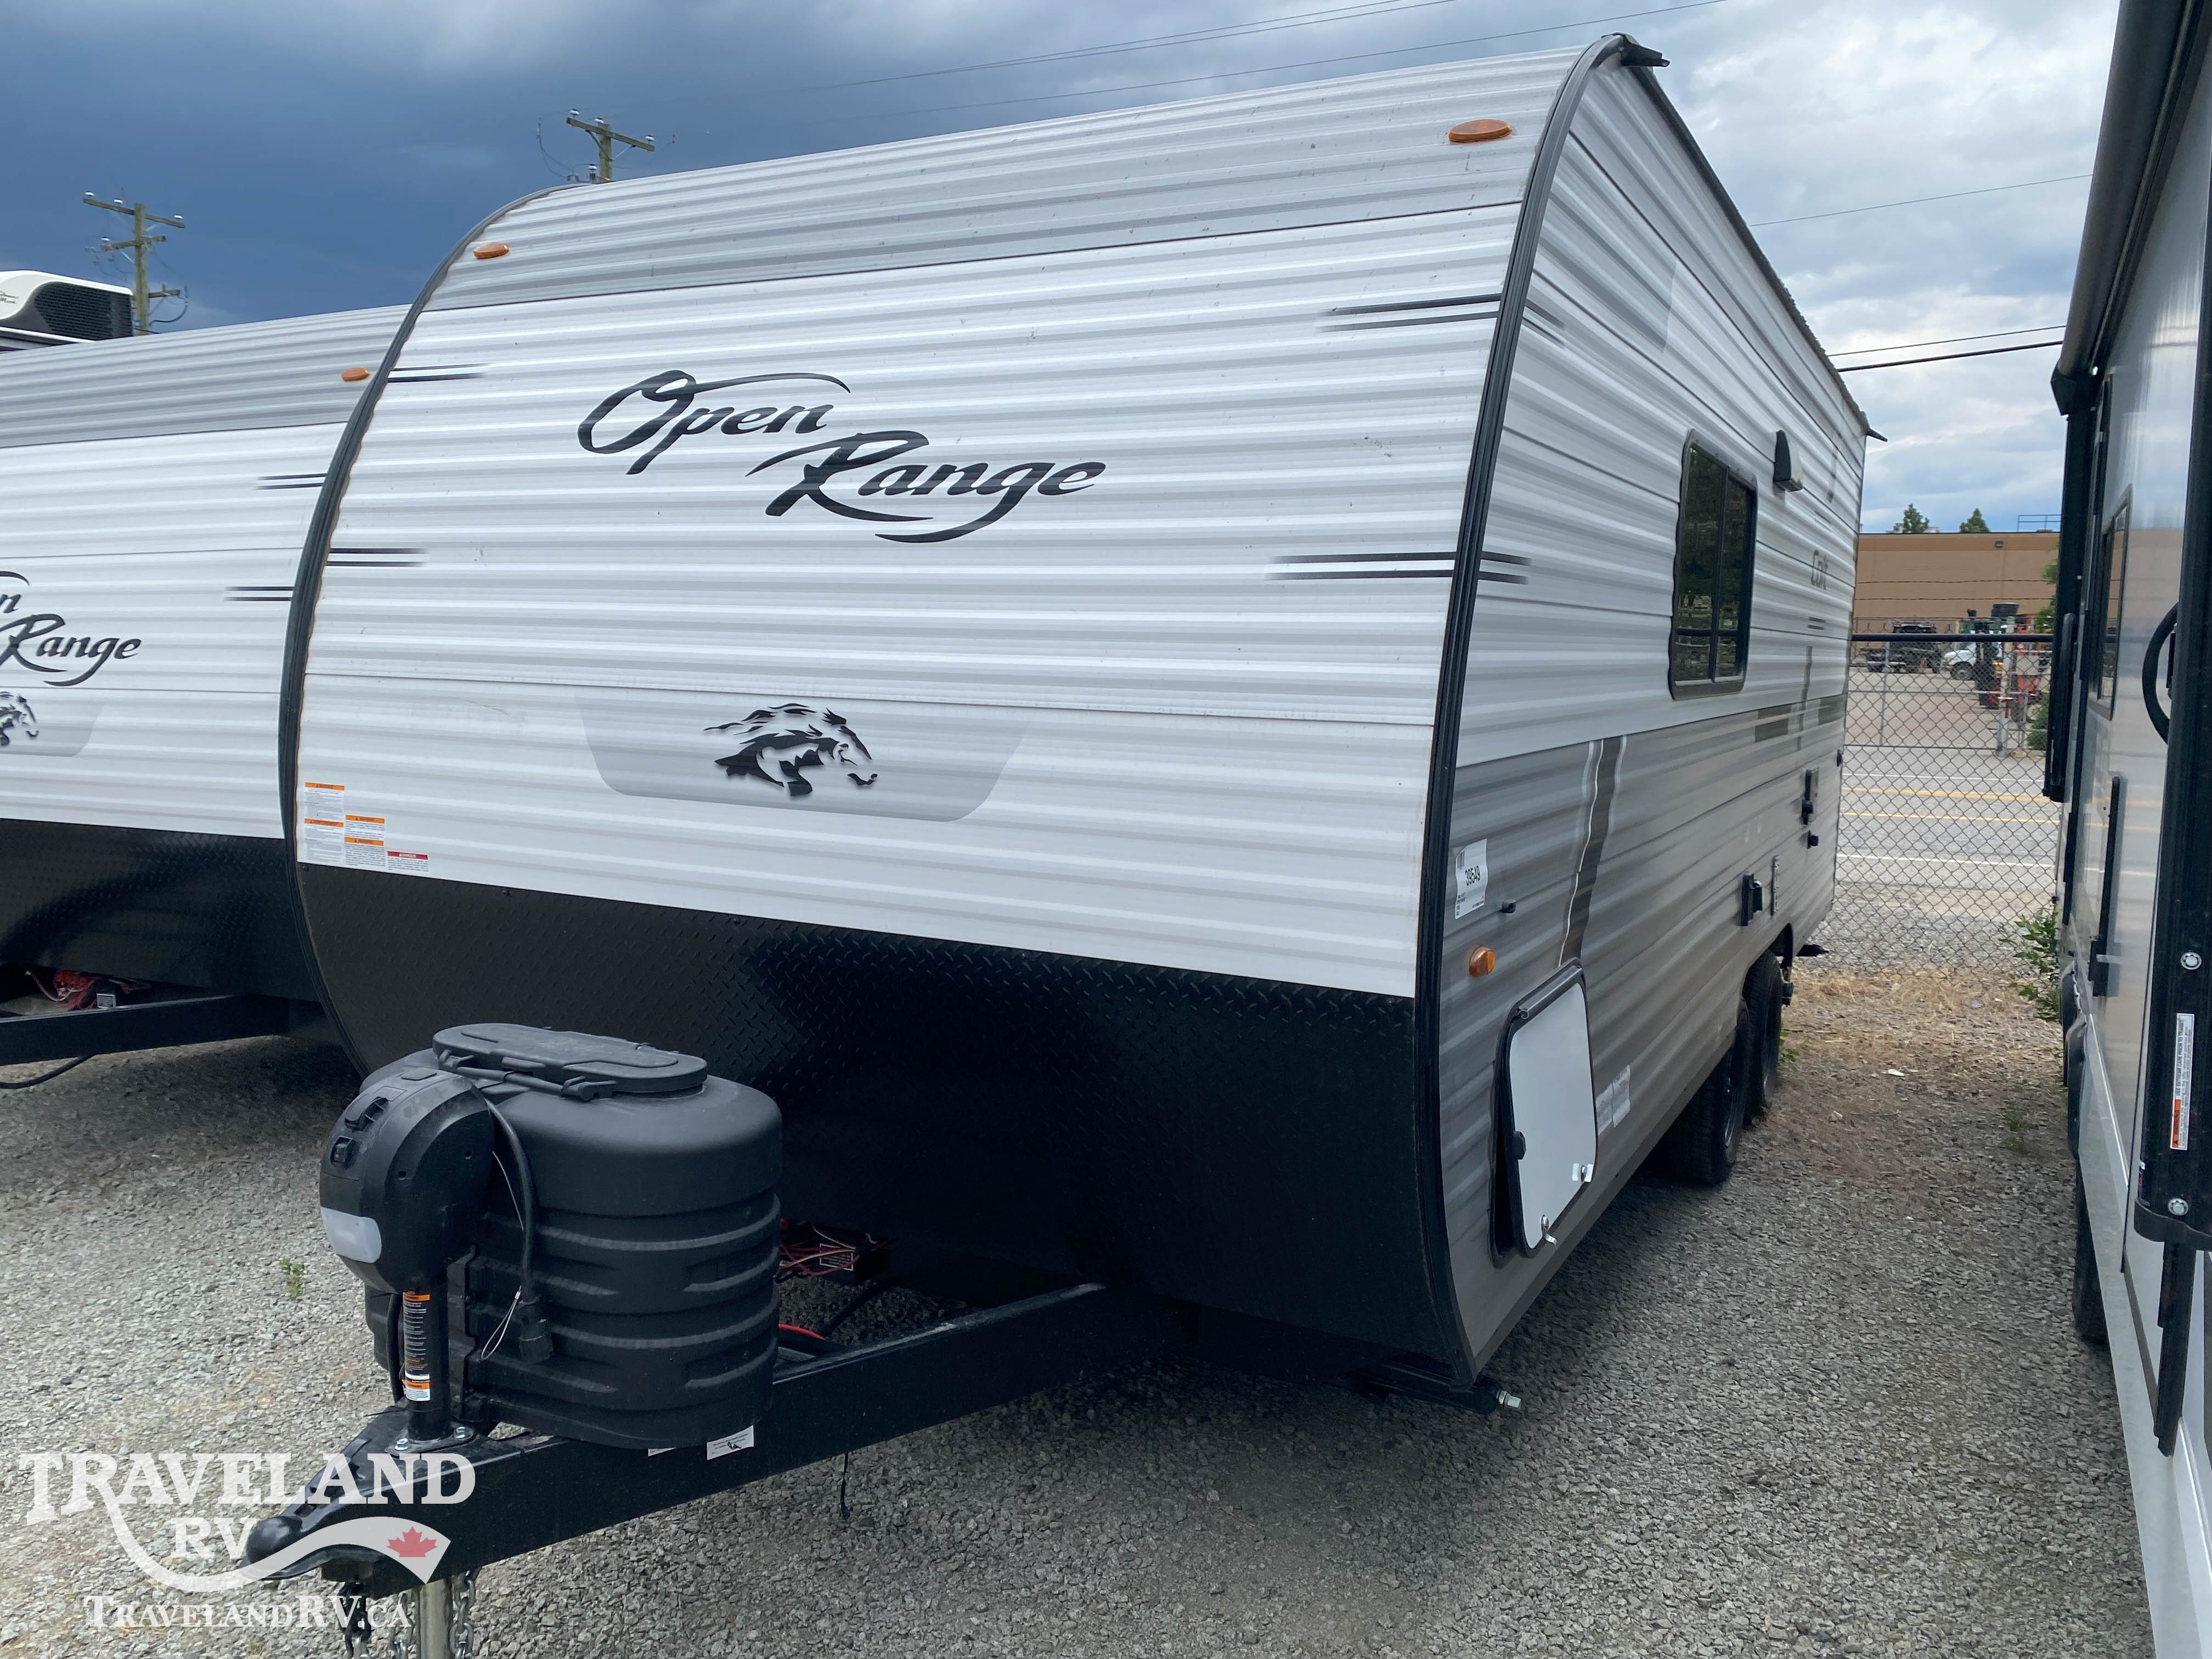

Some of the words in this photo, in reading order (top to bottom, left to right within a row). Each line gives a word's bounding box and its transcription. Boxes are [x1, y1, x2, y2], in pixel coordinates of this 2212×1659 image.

[578, 370, 850, 475] Open
[745, 430, 1106, 543] Range
[0, 613, 142, 686] Range
[1464, 865, 1481, 887] 39549
